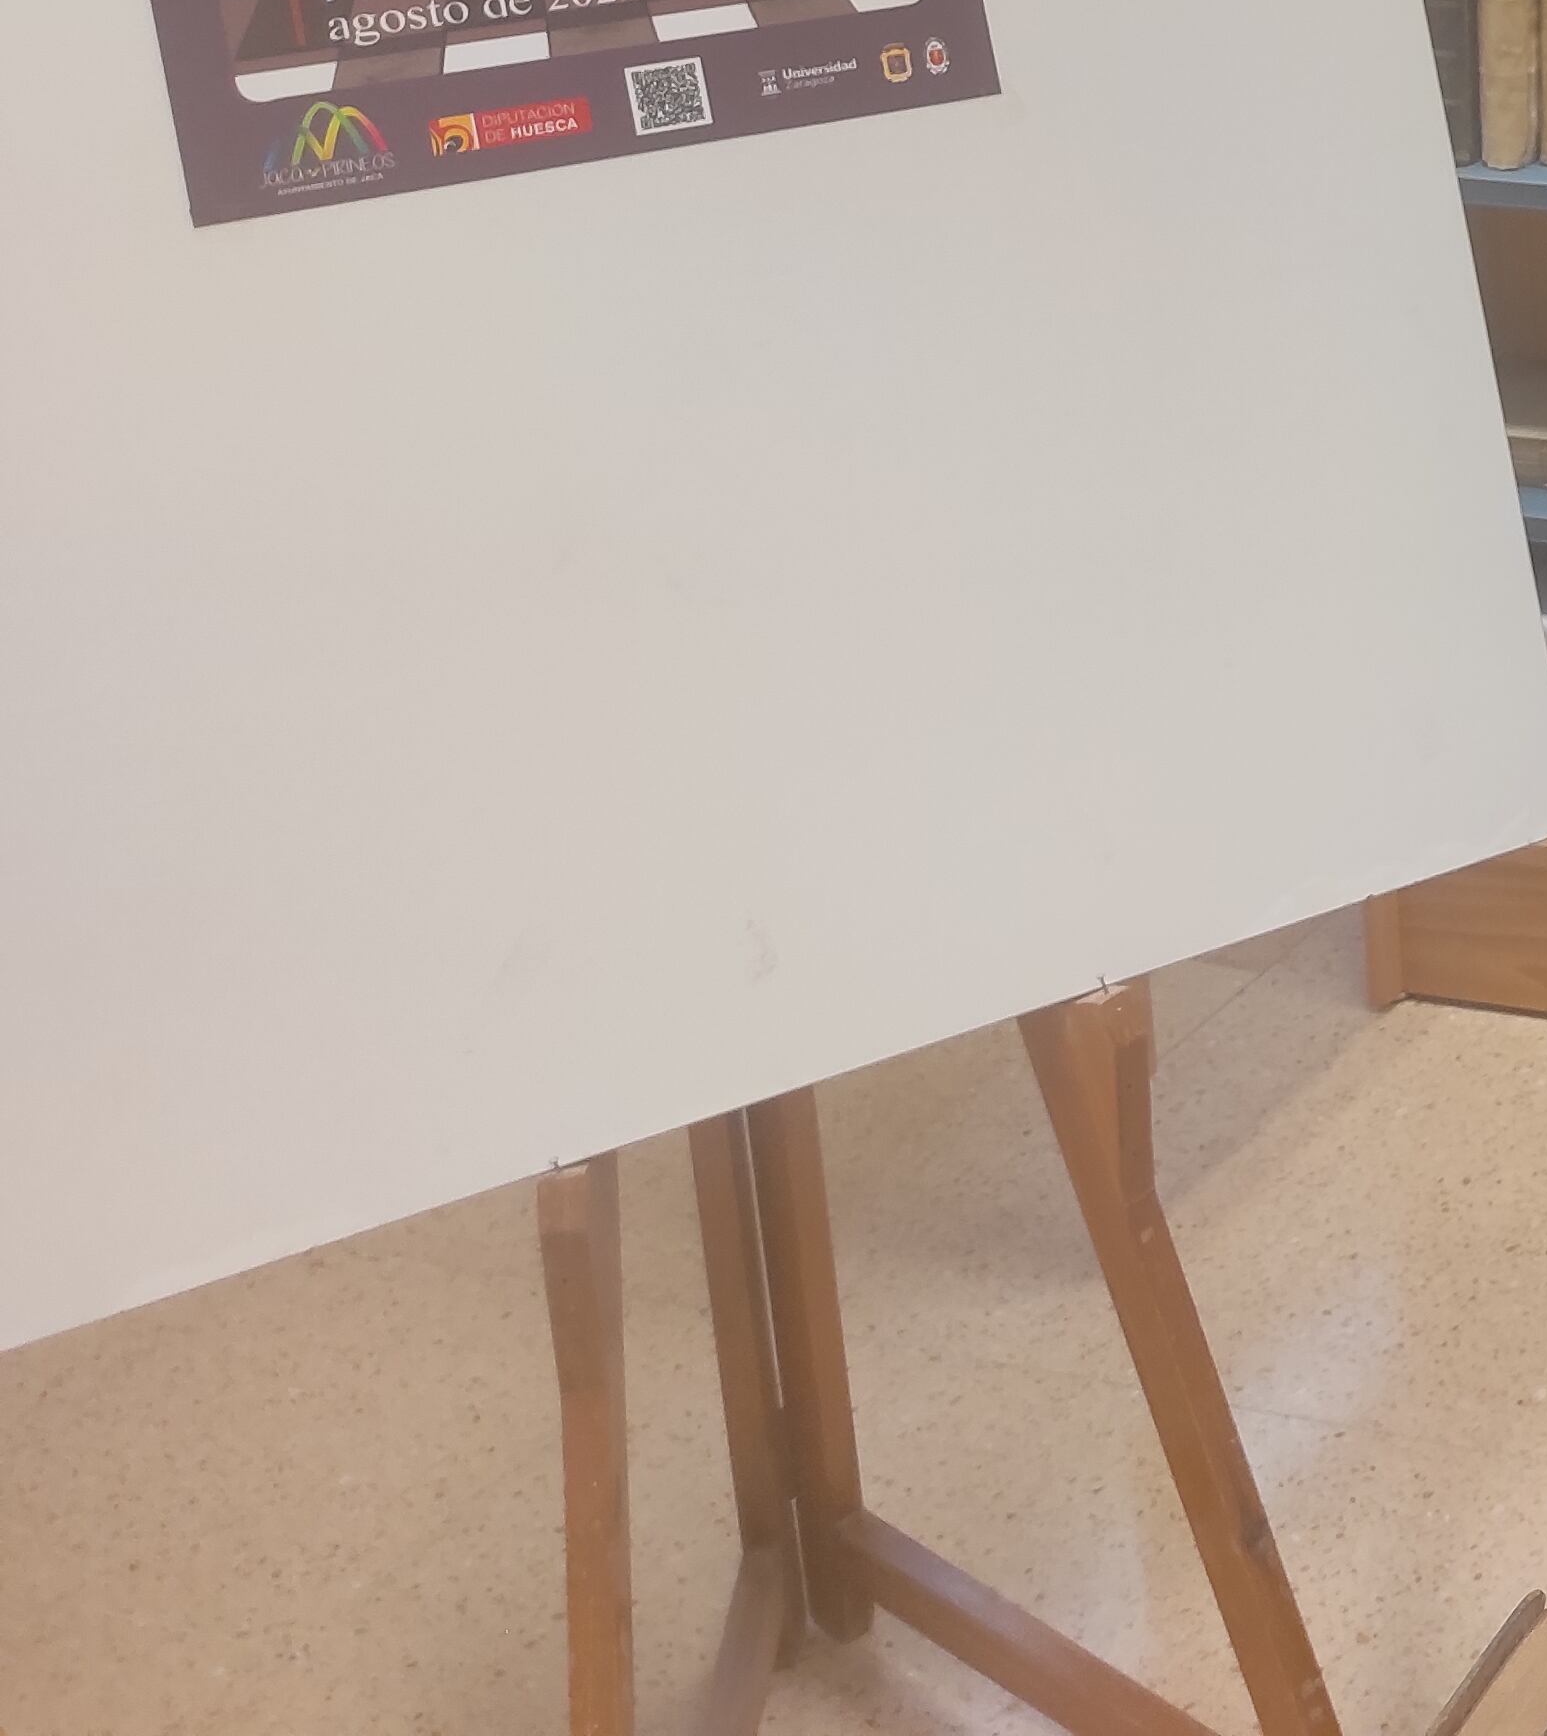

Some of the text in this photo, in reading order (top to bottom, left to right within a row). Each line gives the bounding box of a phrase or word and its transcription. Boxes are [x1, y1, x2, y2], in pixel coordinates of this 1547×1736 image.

[781, 57, 857, 80] Universidad
[485, 116, 579, 144] DE HUESCA
[321, 150, 397, 178] PIRINEOS
